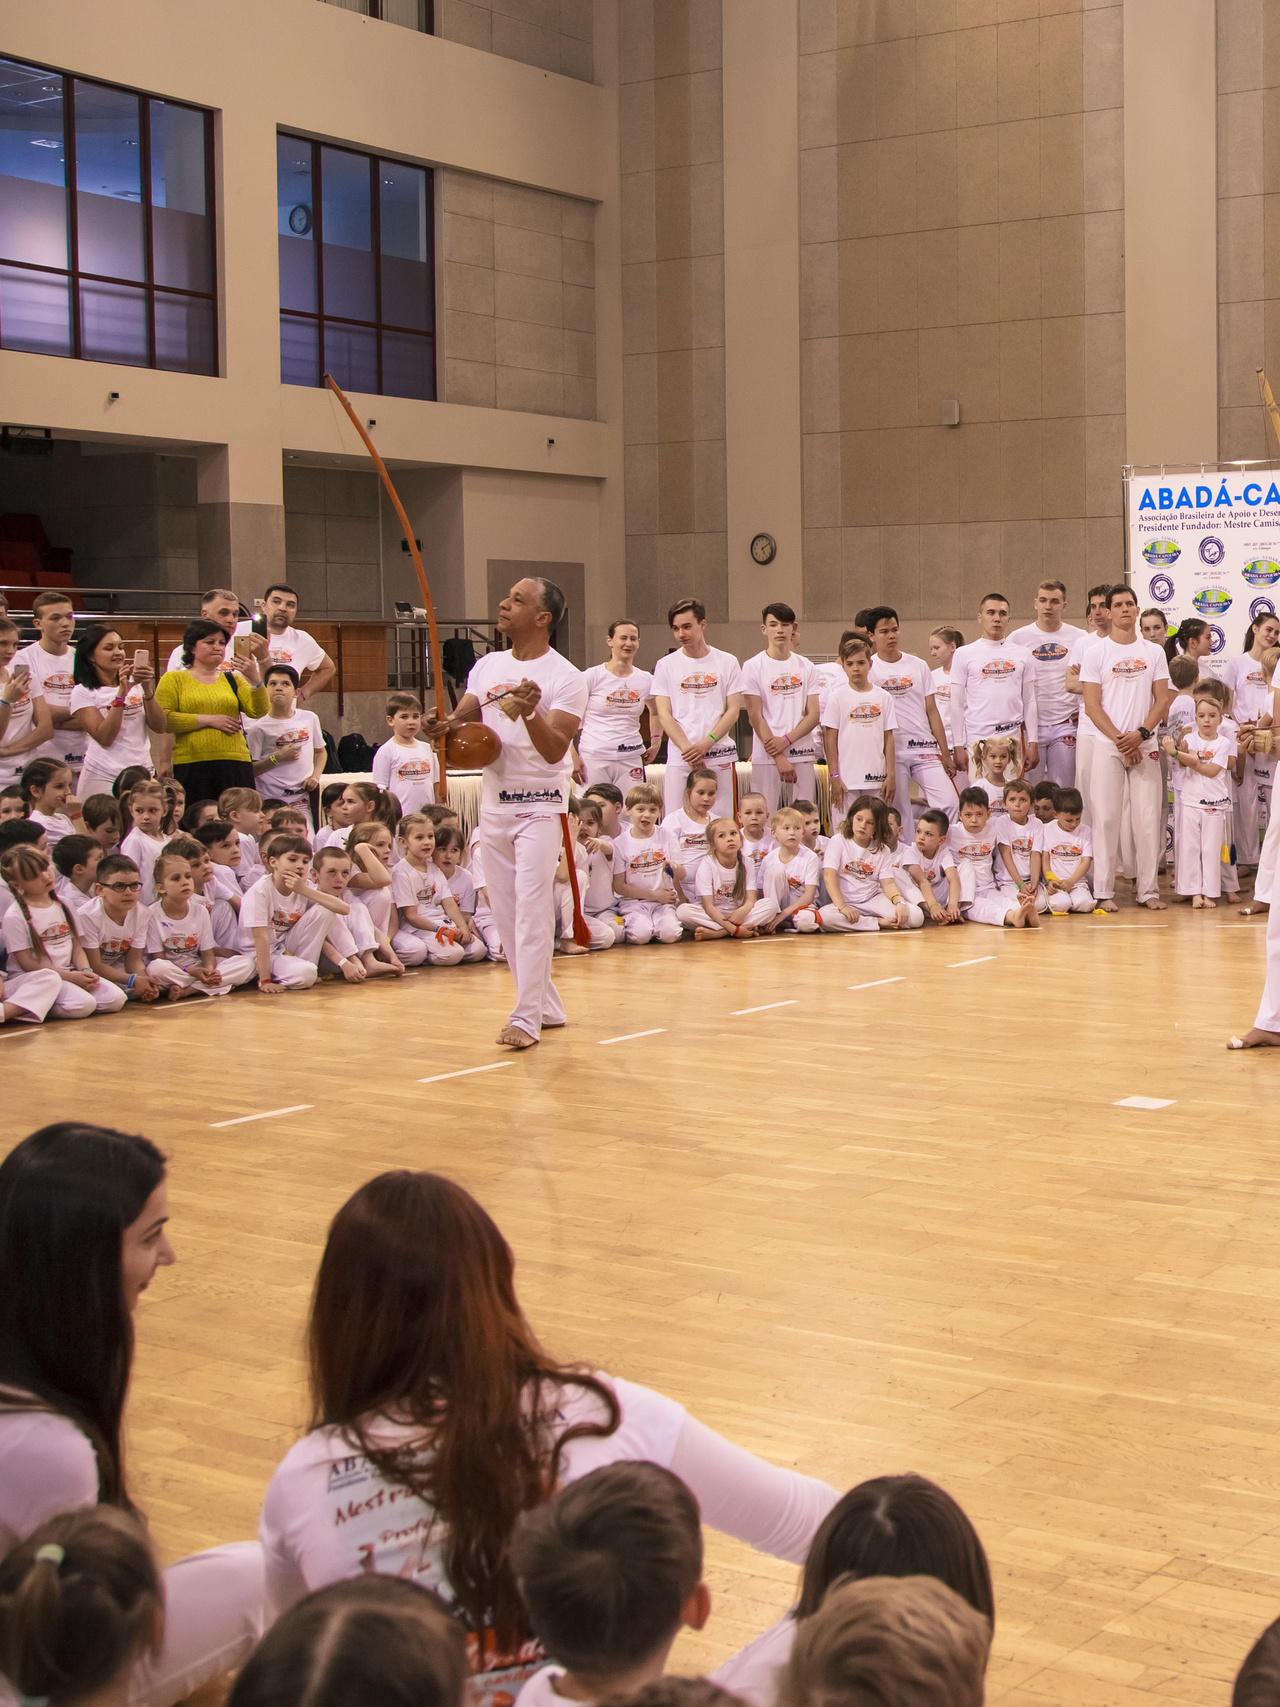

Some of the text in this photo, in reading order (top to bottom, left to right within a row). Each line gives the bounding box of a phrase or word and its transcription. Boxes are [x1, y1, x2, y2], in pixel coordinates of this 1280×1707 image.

[1138, 512, 1178, 522] Associação
[1180, 511, 1215, 520] Brasileira
[1216, 510, 1226, 519] de
[1228, 509, 1251, 520] Apoio
[1138, 523, 1179, 532] Presidente
[1181, 521, 1222, 531] Fundador:
[1224, 520, 1252, 529] Mestre
